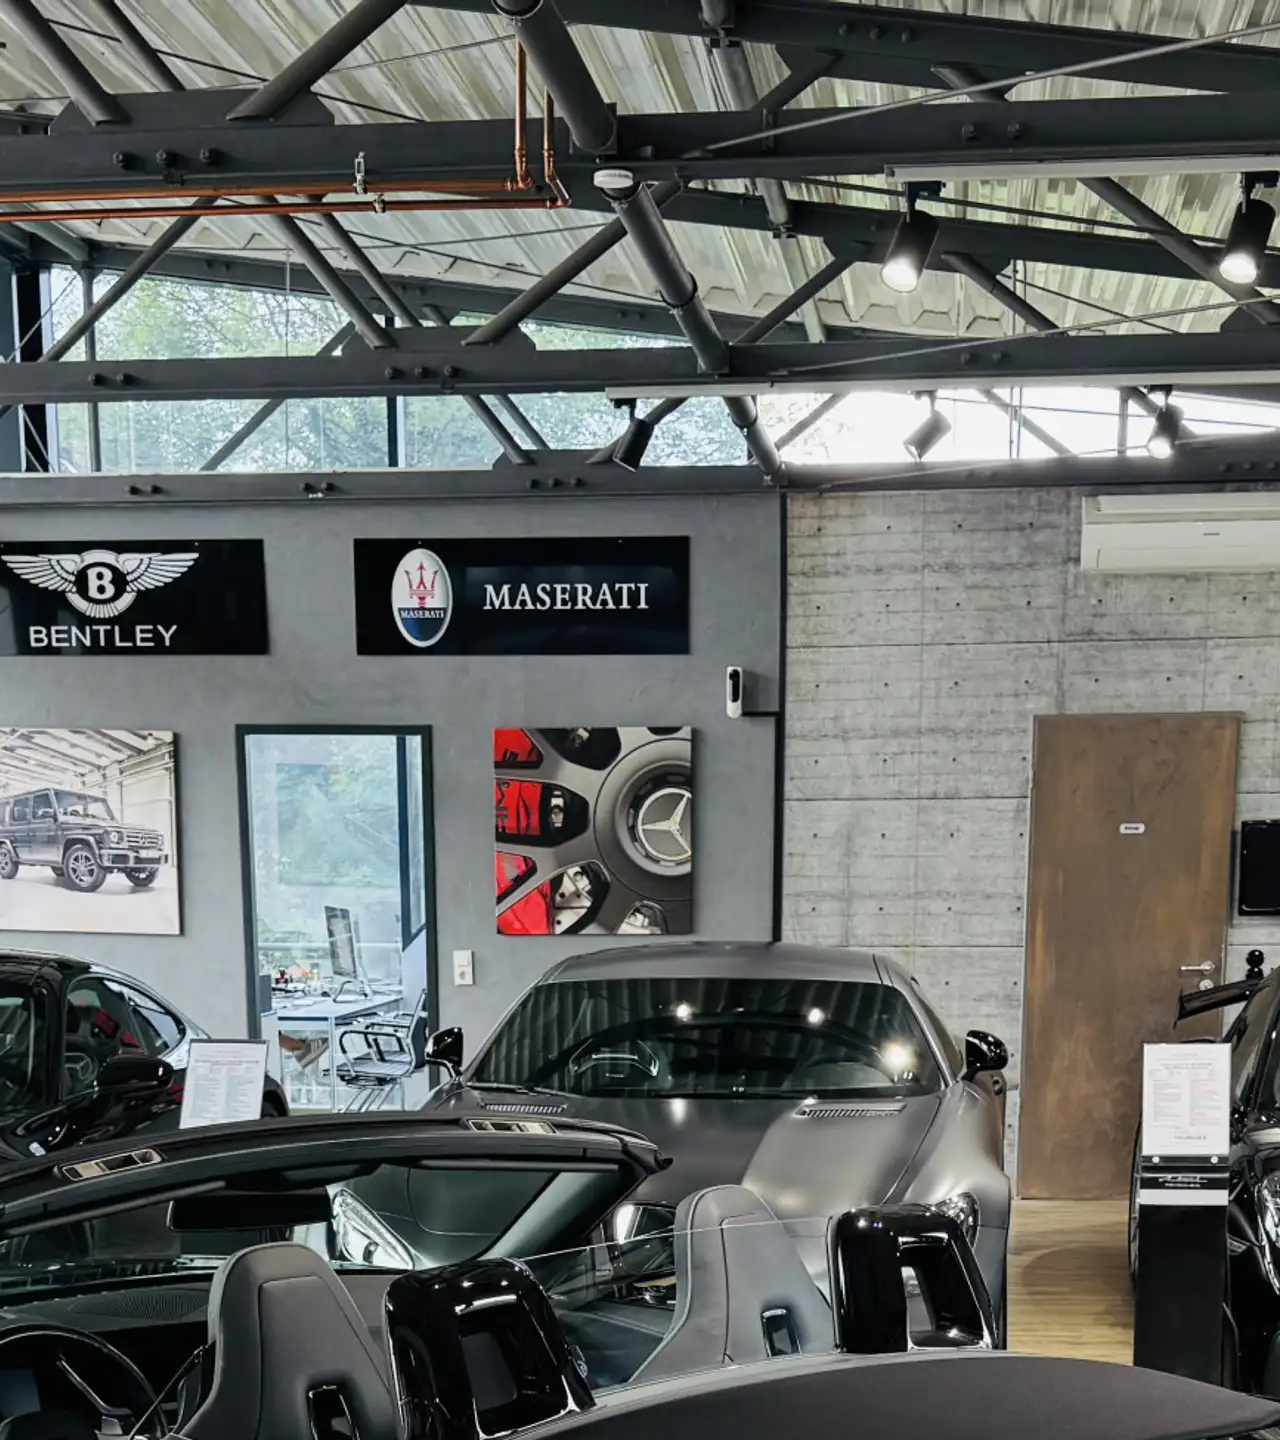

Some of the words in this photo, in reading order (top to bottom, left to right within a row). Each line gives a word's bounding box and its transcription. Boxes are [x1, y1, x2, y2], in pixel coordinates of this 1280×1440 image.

[86, 566, 115, 600] B
[483, 583, 649, 610] MASERATI
[400, 608, 445, 619] MASERATI
[28, 625, 178, 647] BENTLEY
